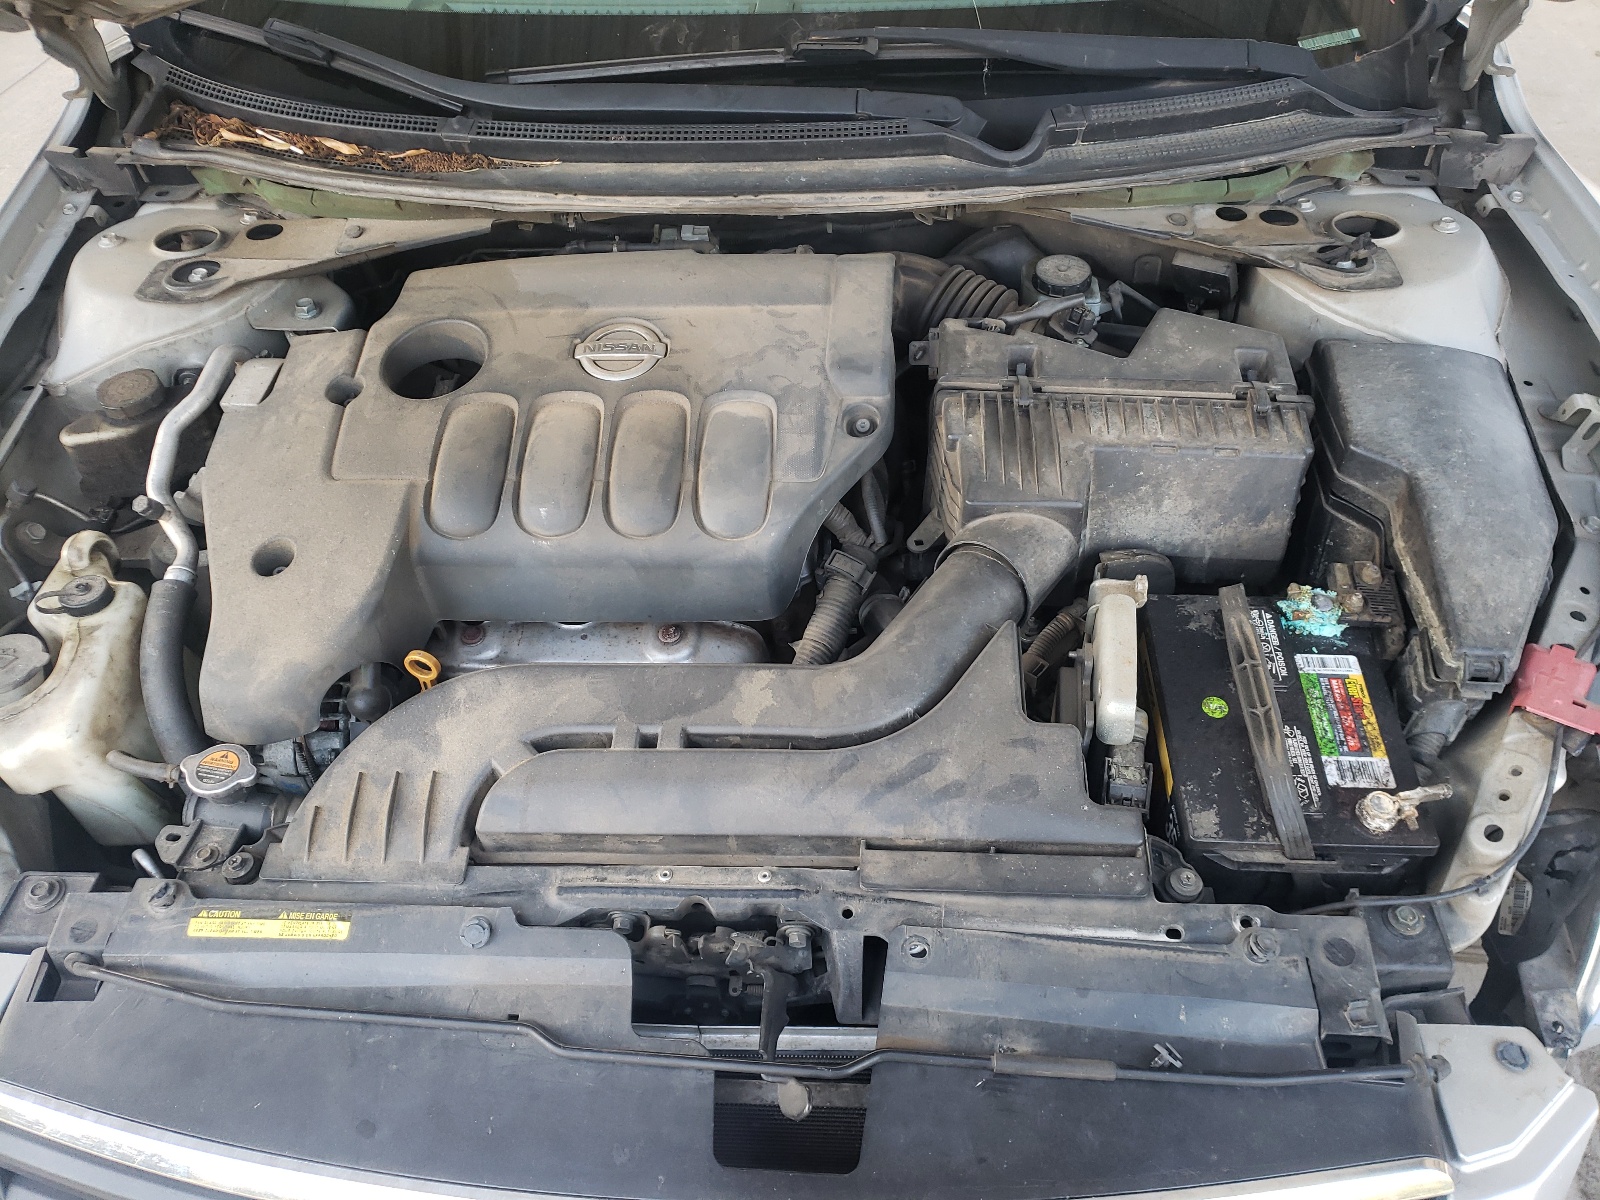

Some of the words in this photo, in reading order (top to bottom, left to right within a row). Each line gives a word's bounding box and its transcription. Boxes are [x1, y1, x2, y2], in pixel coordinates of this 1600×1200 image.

[583, 342, 656, 353] NISSAN
[1266, 619, 1279, 645] DANGER
[1274, 651, 1288, 675] POISON
[208, 910, 242, 918] CAUTION
[288, 912, 305, 920] MISE
[305, 912, 316, 920] EN
[315, 912, 338, 920] GARDE
